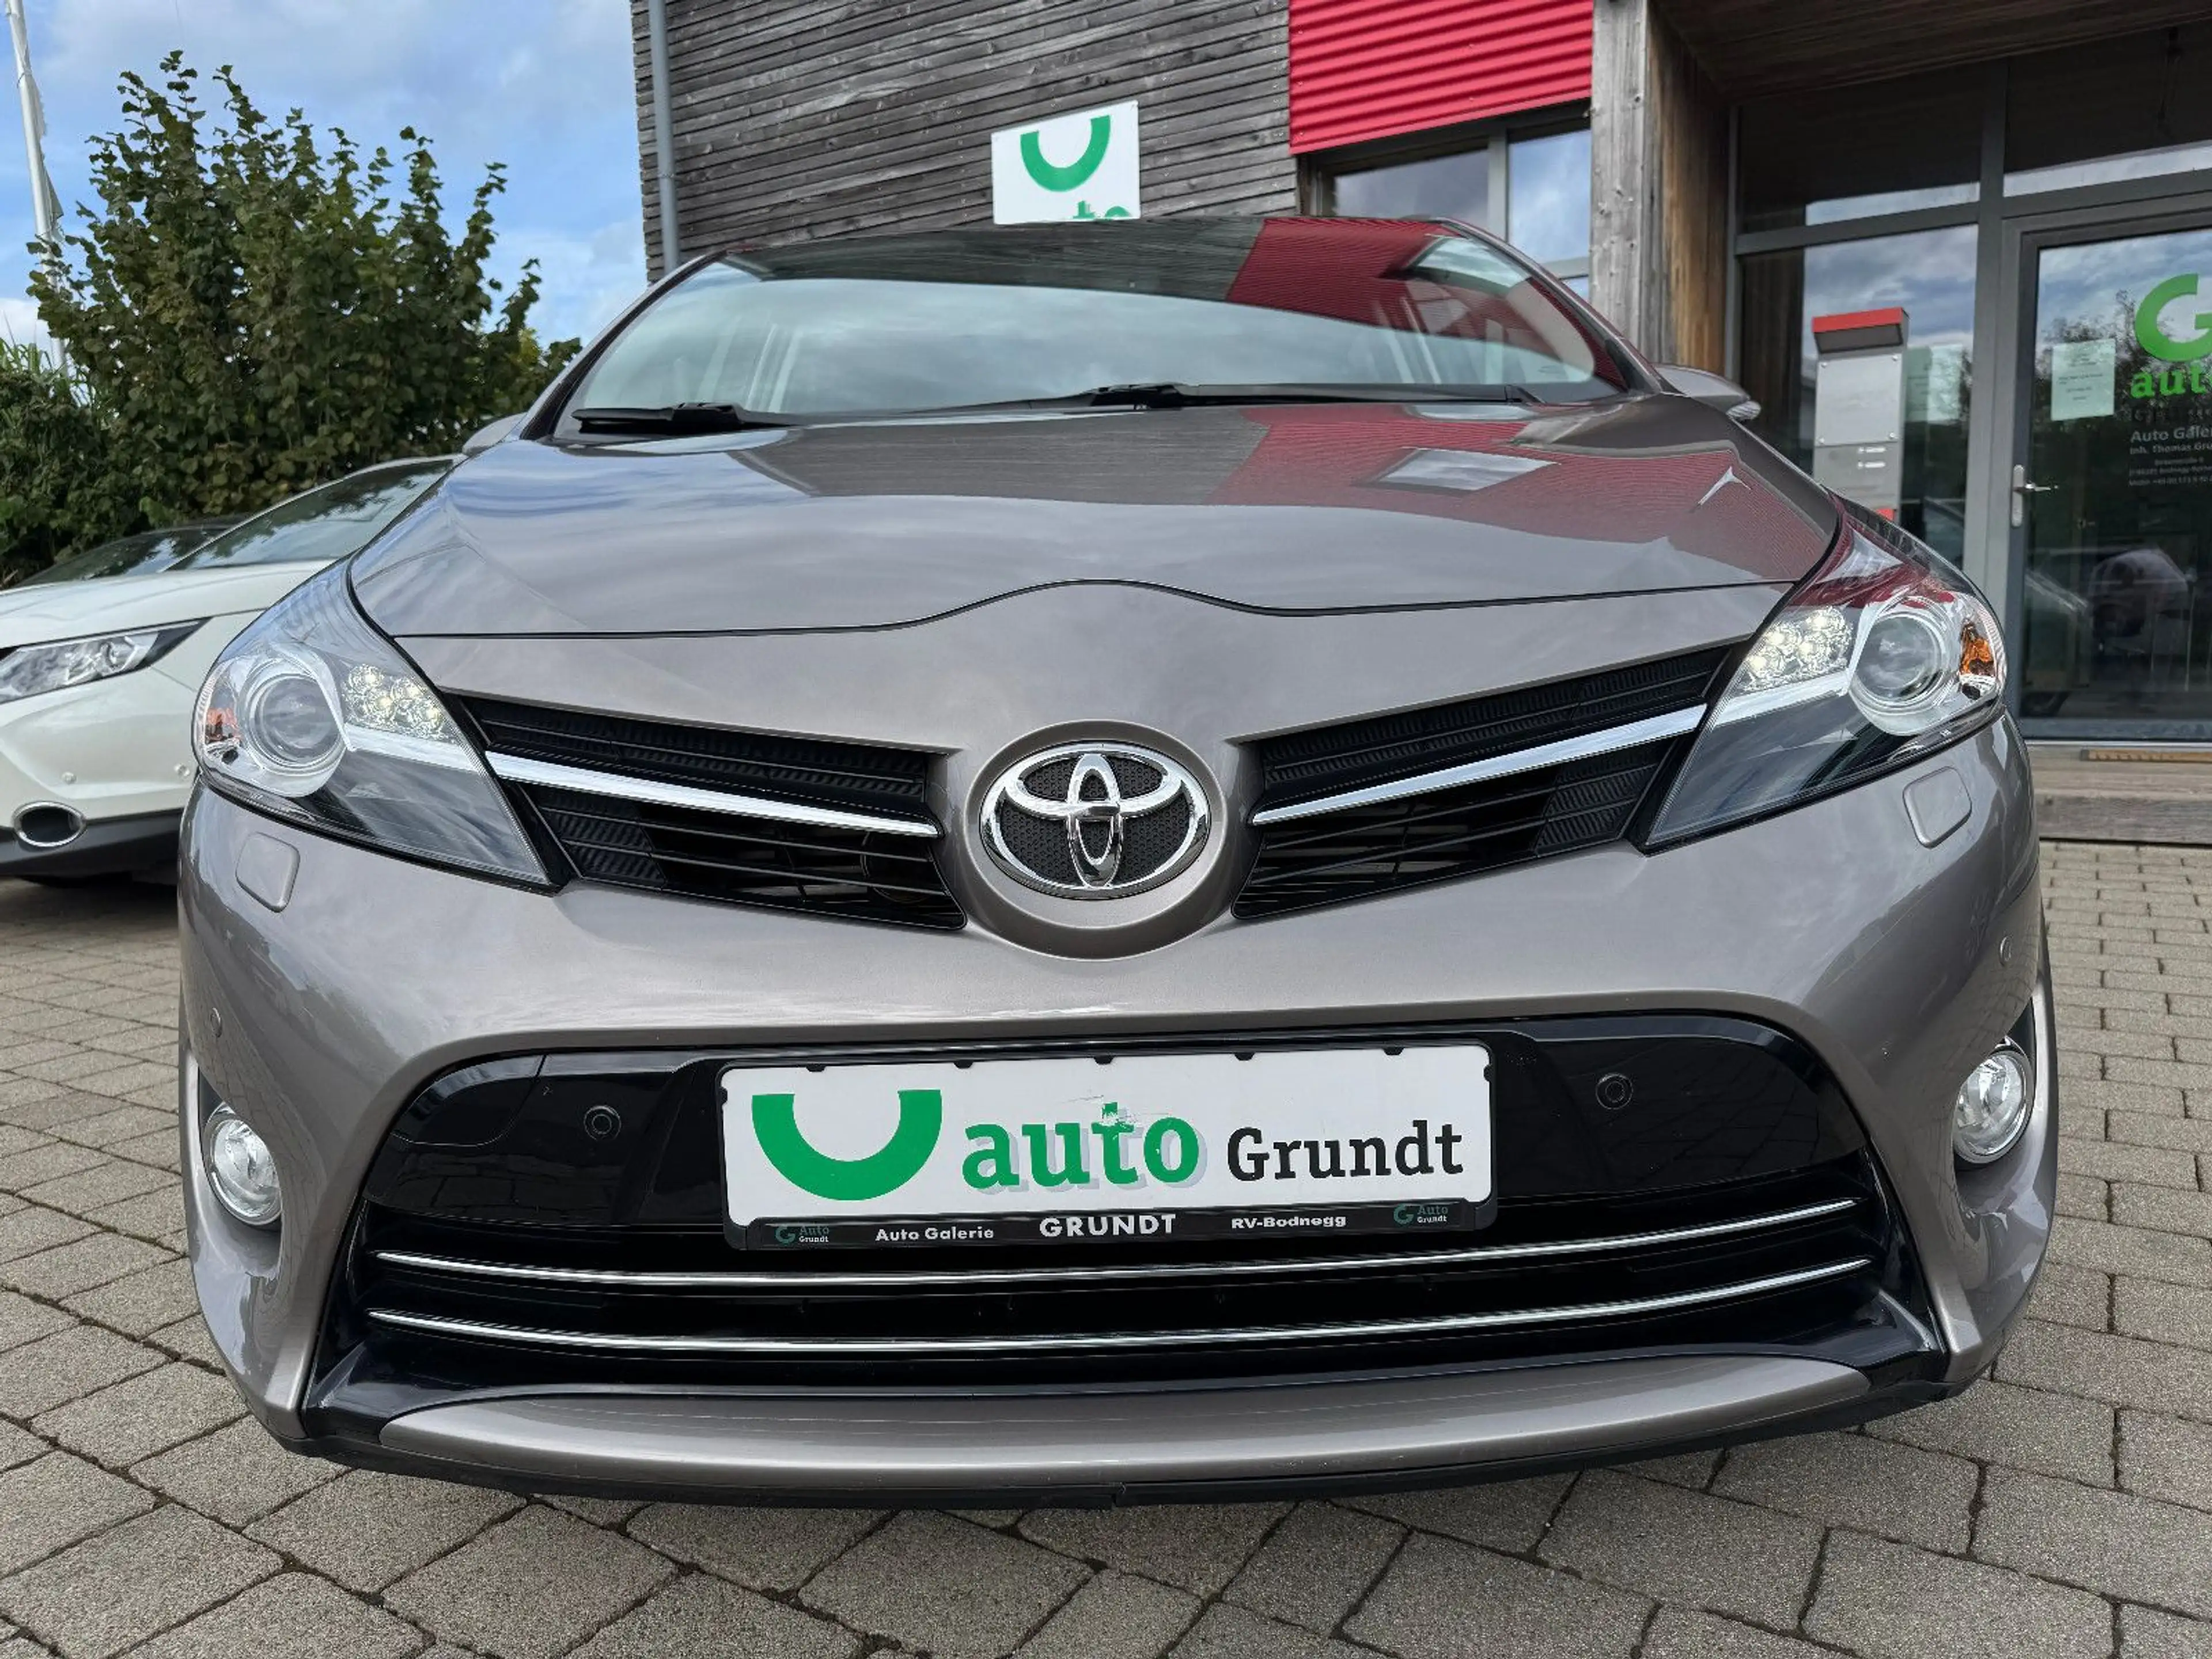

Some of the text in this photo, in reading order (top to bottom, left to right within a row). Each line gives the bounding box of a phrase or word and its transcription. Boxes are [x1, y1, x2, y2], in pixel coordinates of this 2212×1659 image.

[2130, 361, 2212, 398] aut
[2130, 429, 2169, 443] Auto
[961, 1101, 1464, 1190] auto Grundt
[1417, 1205, 1449, 1215] Auto
[1417, 1215, 1448, 1224] Grundt
[799, 1225, 830, 1236] Auto
[874, 1213, 1347, 1242] Auto Galerie GRUNDT RV-Bodnegg
[798, 1235, 830, 1243] Grundt
